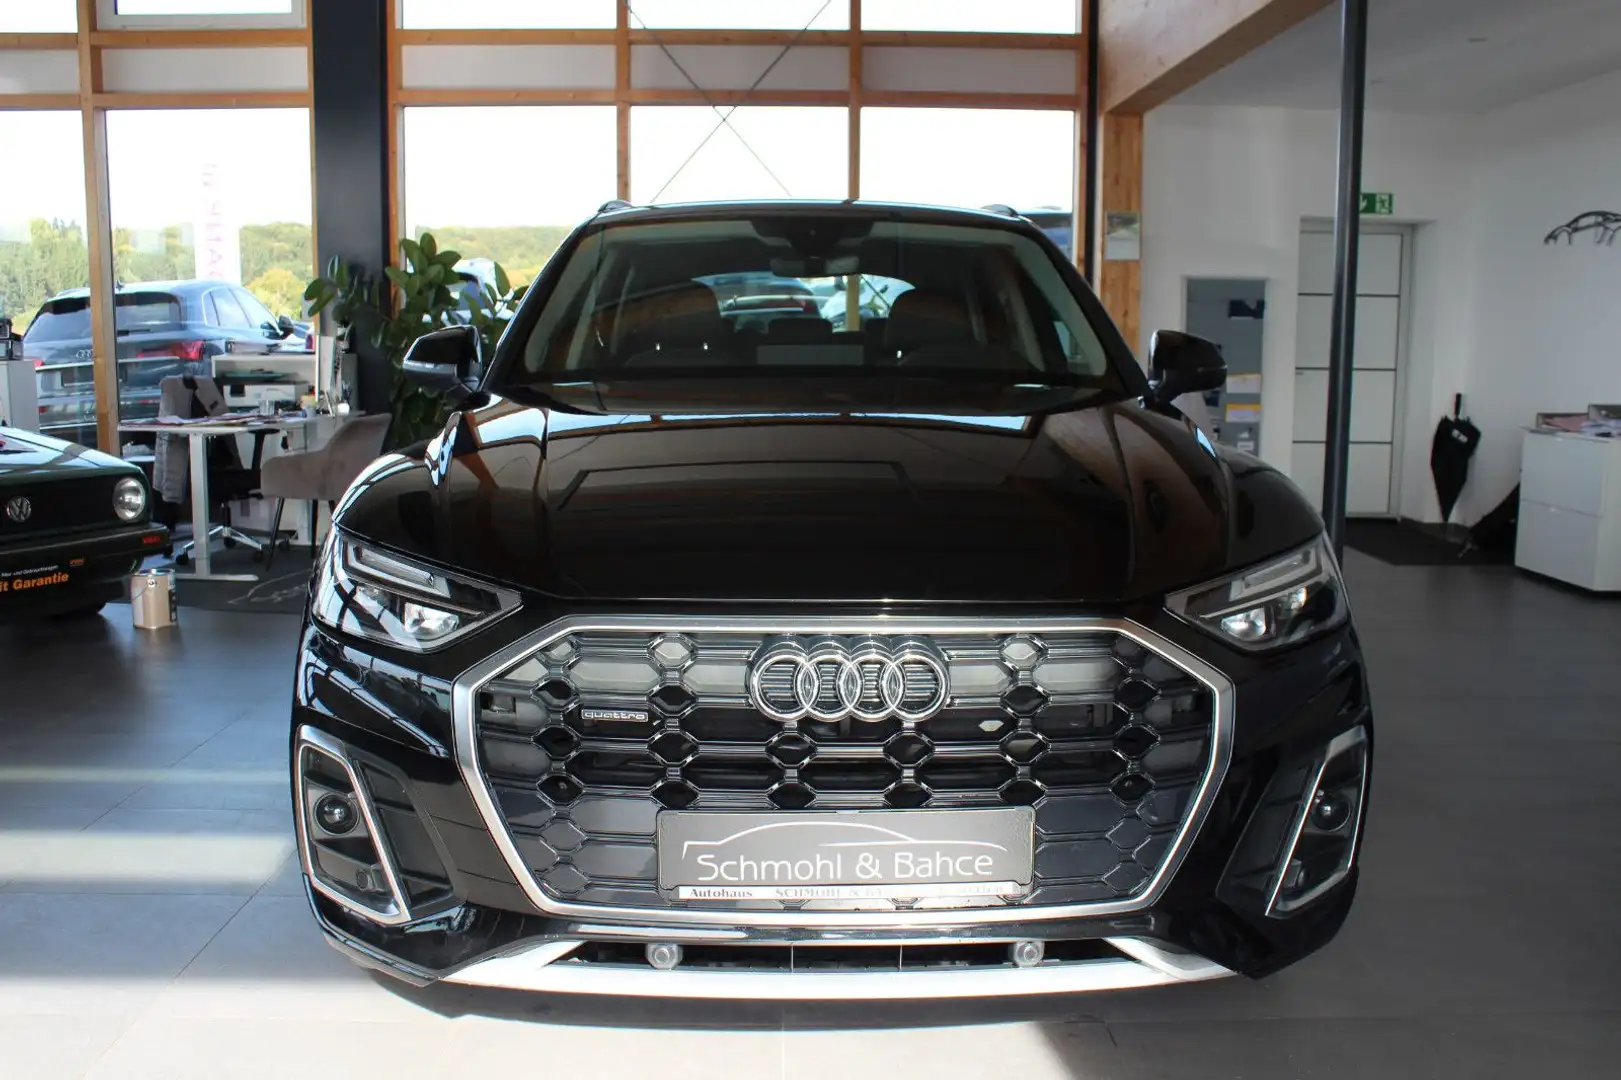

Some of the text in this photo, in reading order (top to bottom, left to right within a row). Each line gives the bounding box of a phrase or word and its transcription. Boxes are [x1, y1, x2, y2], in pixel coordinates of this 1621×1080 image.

[12, 571, 69, 590] Garantie
[583, 711, 646, 720] quattro
[697, 851, 993, 881] Schmohl & Bahce
[690, 888, 753, 898] Autohaus
